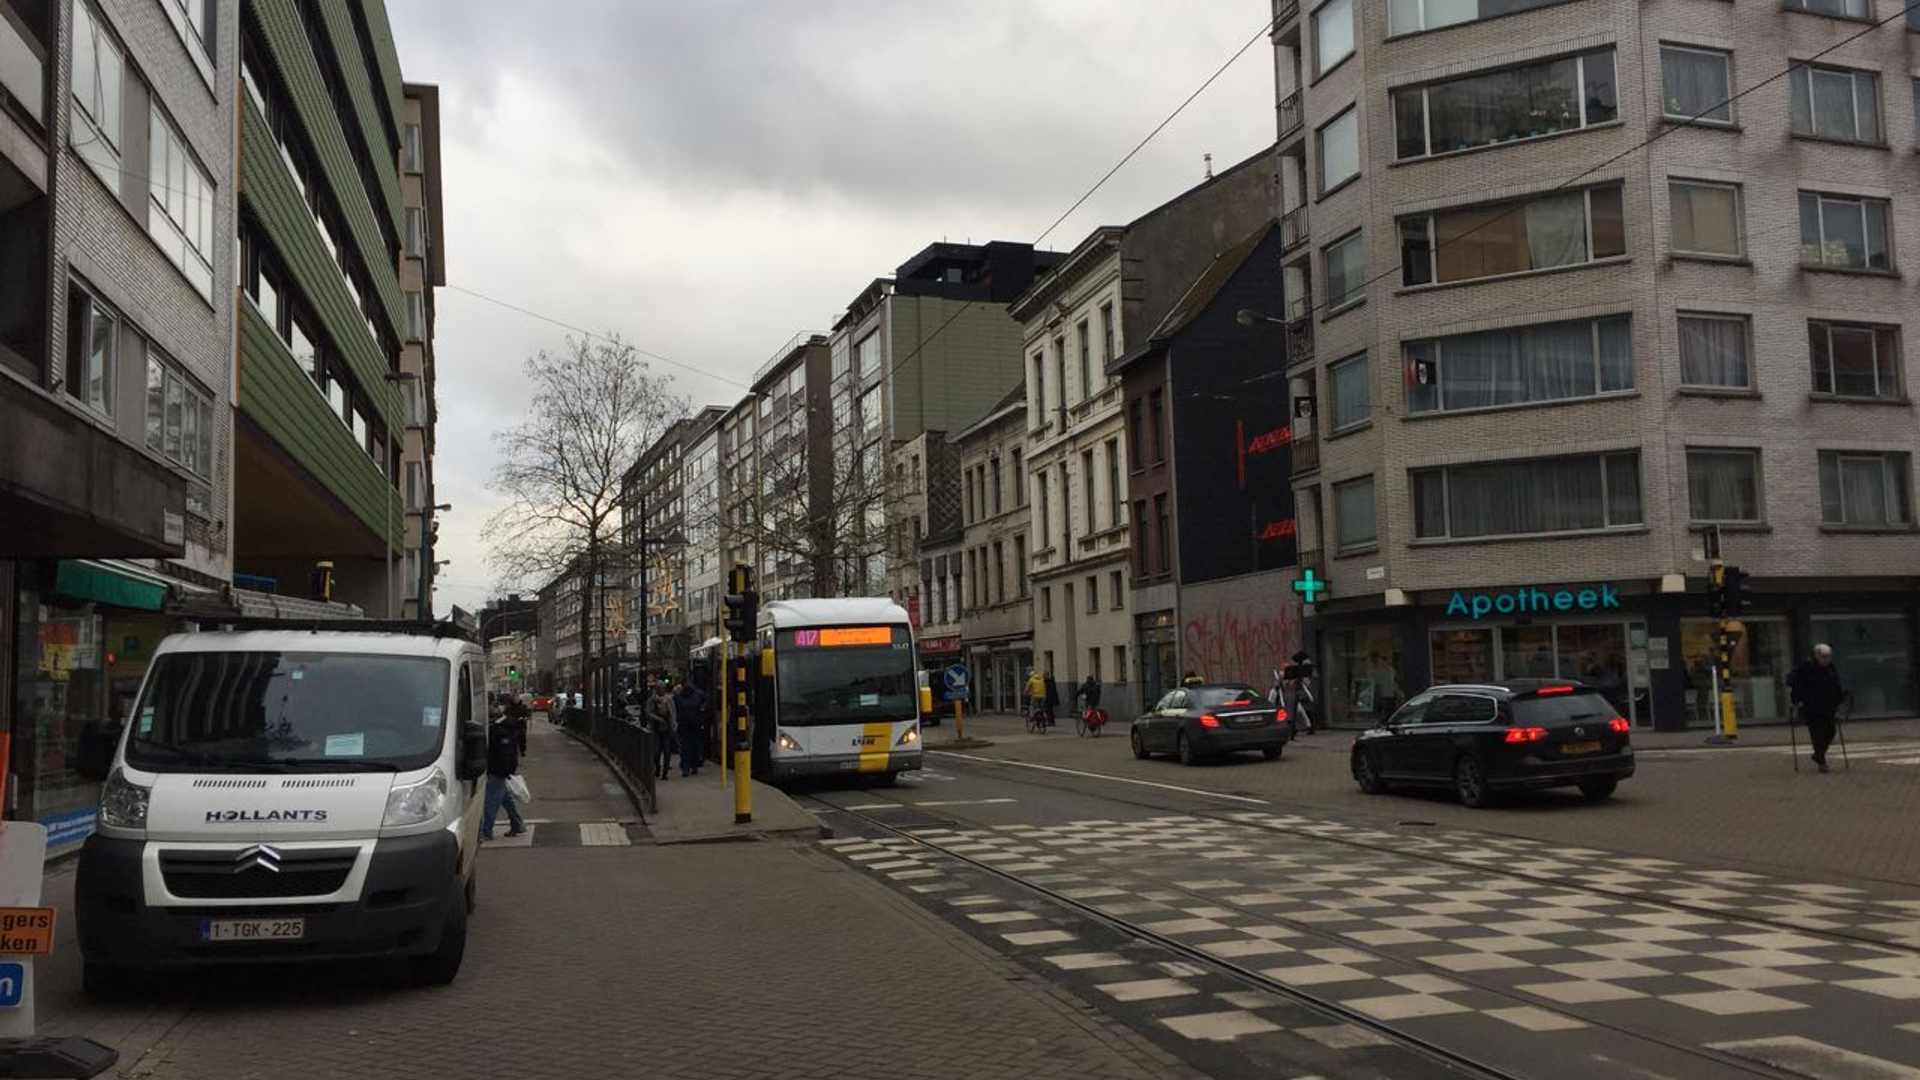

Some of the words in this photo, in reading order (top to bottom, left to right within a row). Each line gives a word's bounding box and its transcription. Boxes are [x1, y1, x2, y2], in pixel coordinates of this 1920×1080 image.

[1446, 583, 1620, 619] Apotheek
[205, 809, 328, 822] HOLLANTS
[2, 914, 48, 931] gers
[213, 922, 302, 938] 1-TGK-225
[1, 934, 38, 951] ken
